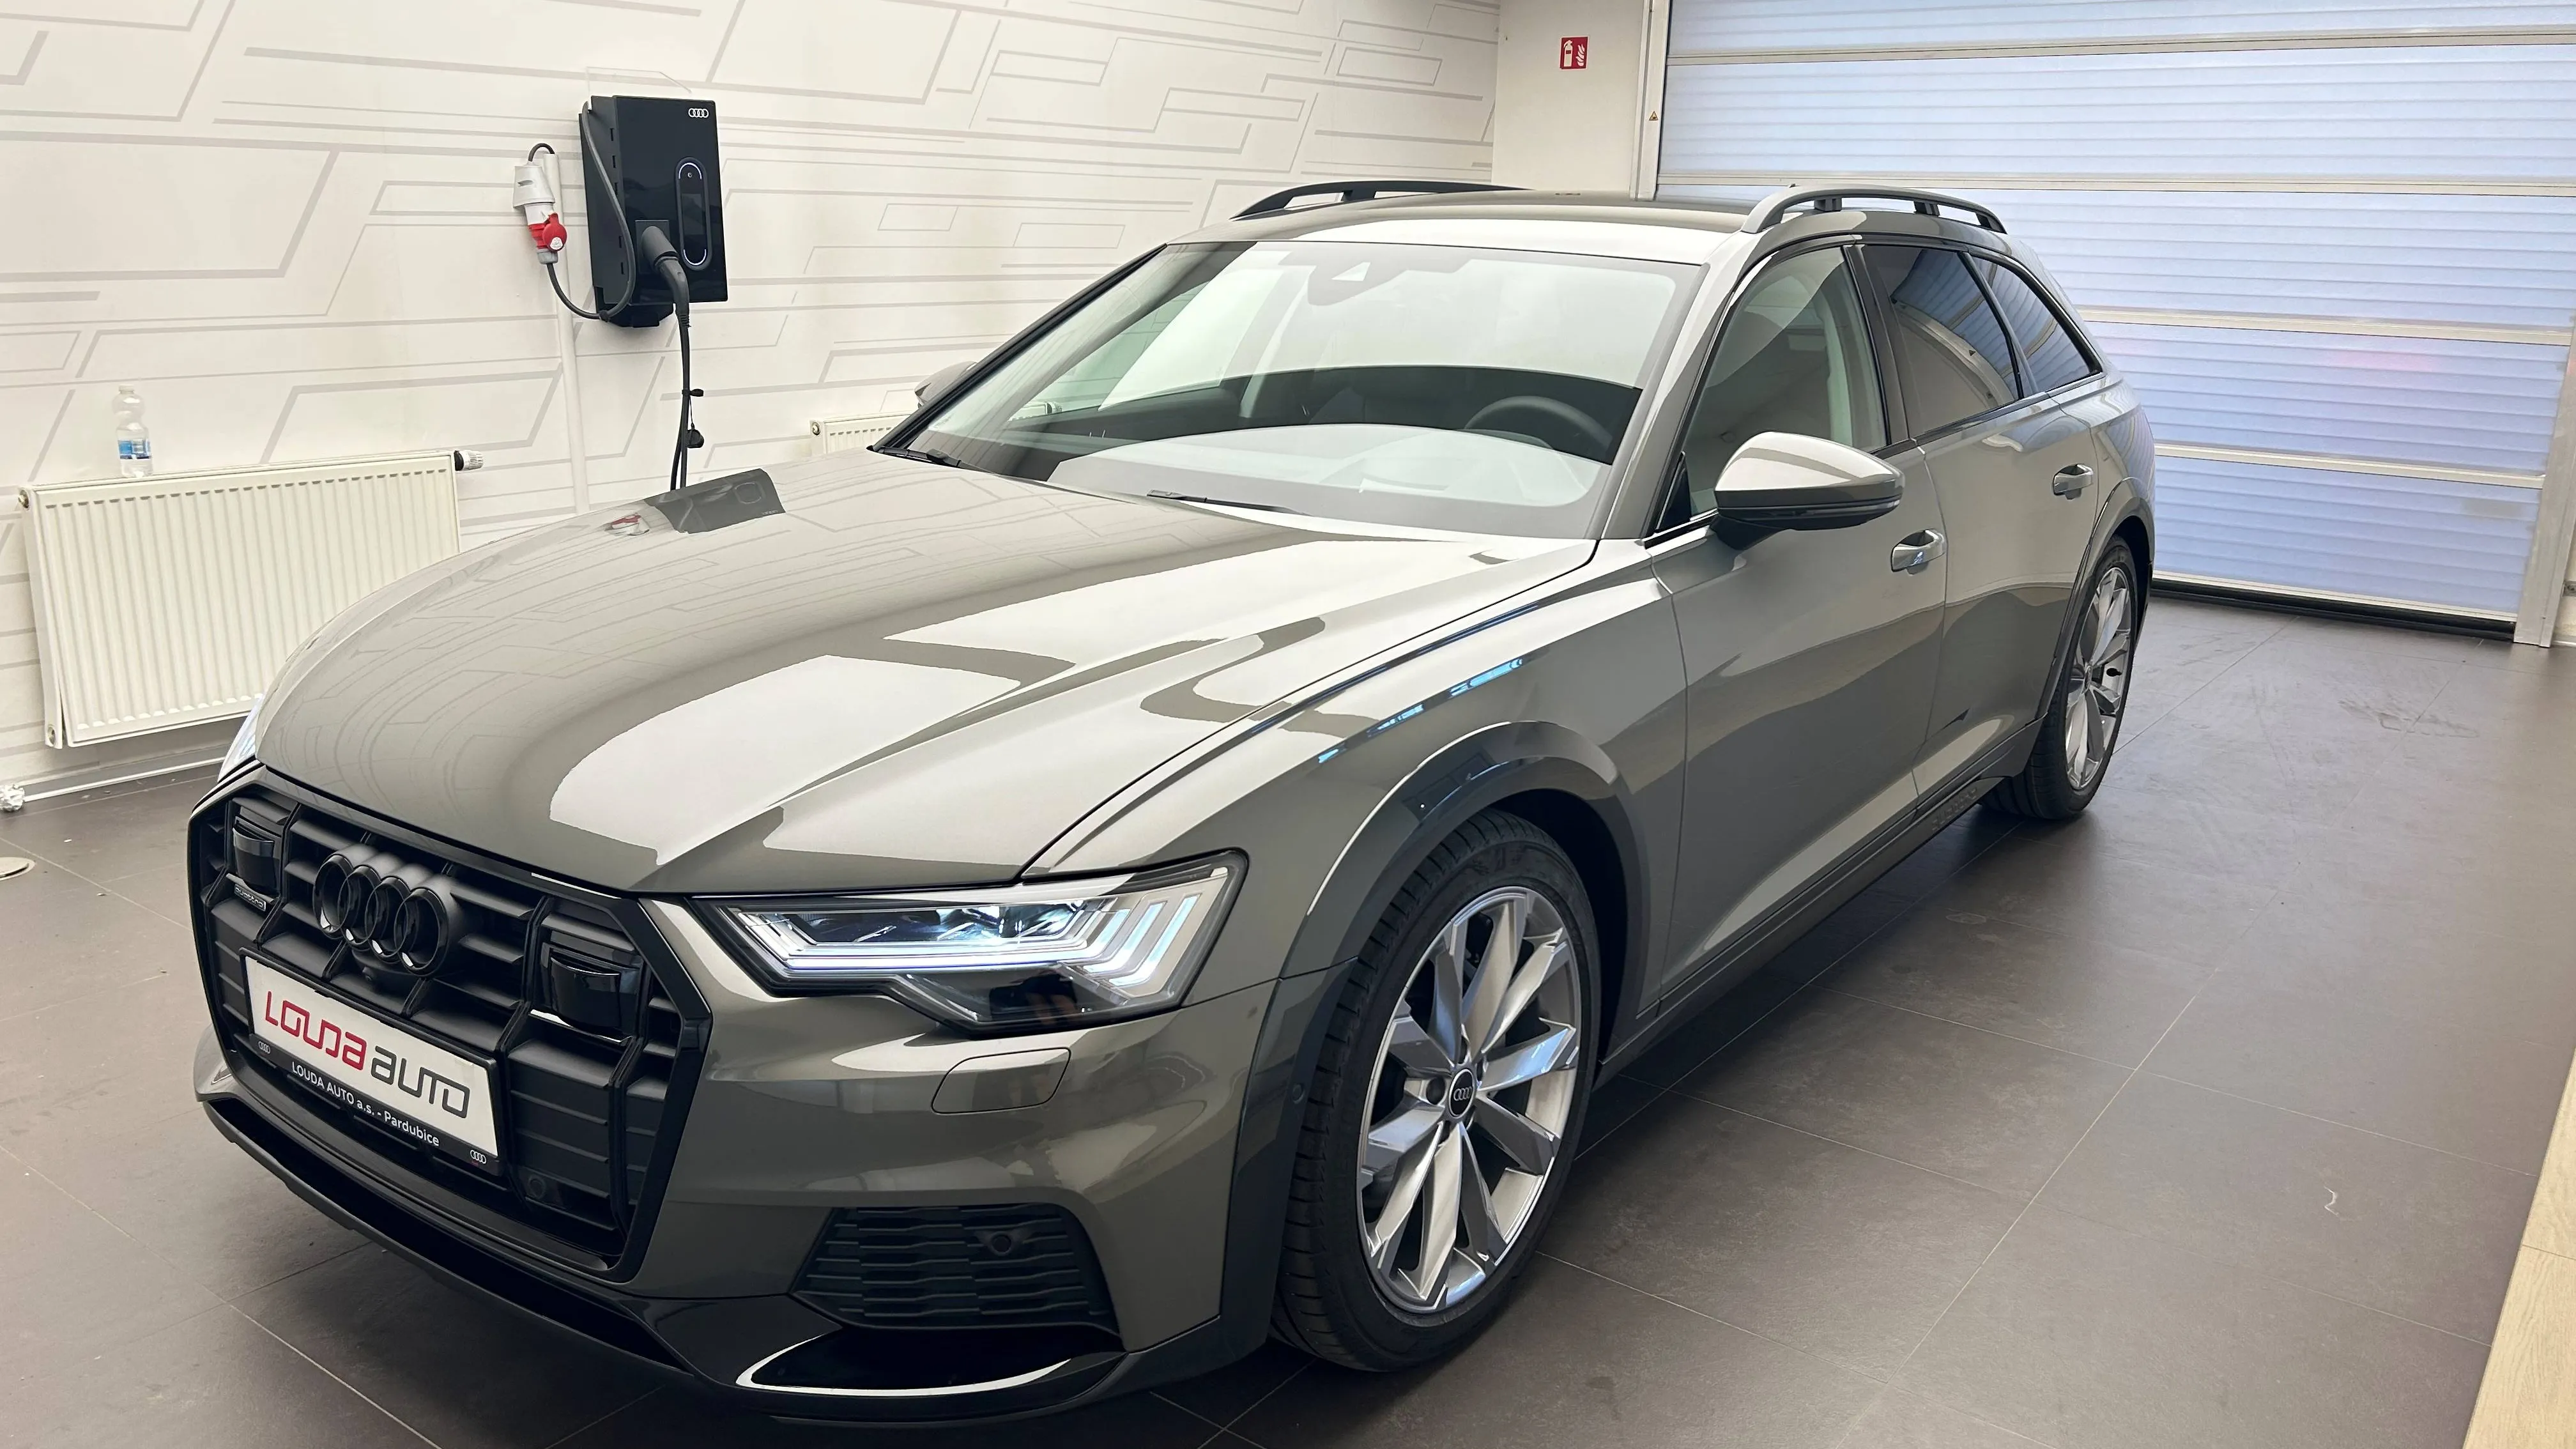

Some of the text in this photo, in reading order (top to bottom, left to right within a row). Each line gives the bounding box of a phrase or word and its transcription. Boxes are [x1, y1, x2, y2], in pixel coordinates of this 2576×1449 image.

[292, 1061, 325, 1089] LOUDA
[326, 1082, 355, 1105] AUTO
[356, 1100, 375, 1116] a.s.
[384, 1110, 440, 1146] Pardubice
